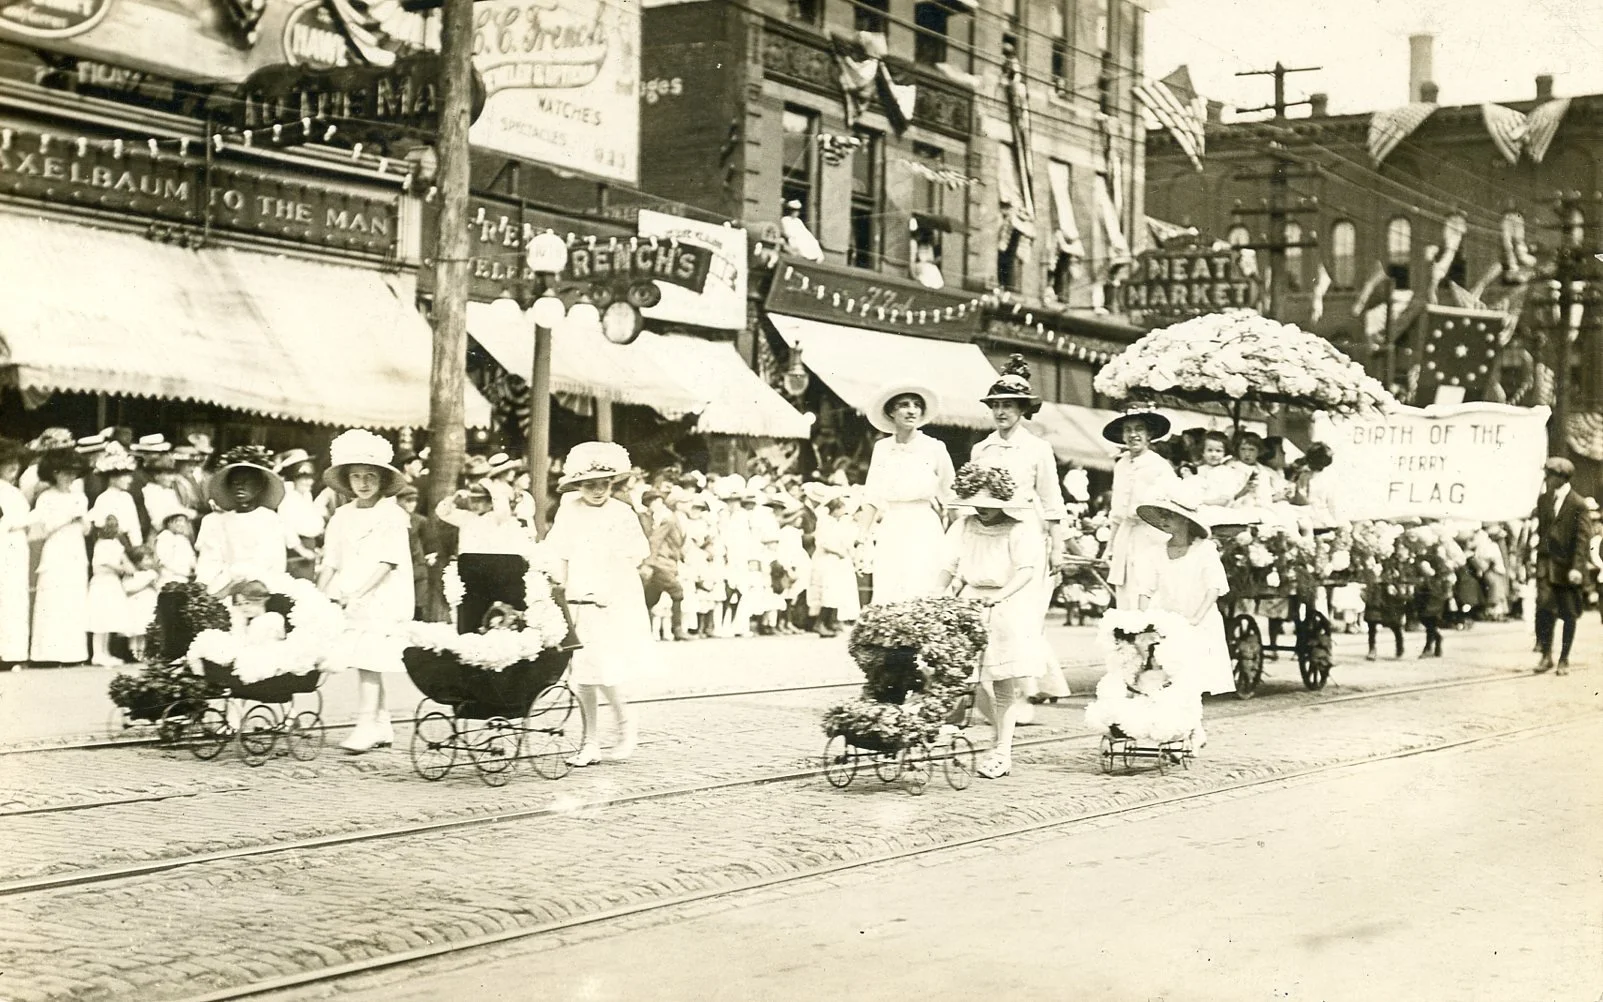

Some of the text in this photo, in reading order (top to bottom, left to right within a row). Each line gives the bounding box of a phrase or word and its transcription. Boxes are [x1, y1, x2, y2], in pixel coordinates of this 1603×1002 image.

[538, 96, 602, 126] WATCHES
[208, 188, 244, 211] TO
[257, 195, 313, 222] THE
[326, 208, 388, 236] MAN
[571, 243, 696, 279] RENCH'S
[1127, 283, 1249, 306] MARKET
[1352, 424, 1507, 446] BIRTH OF THE
[1397, 456, 1448, 472] PERRY
[1388, 482, 1466, 504] FLAG
